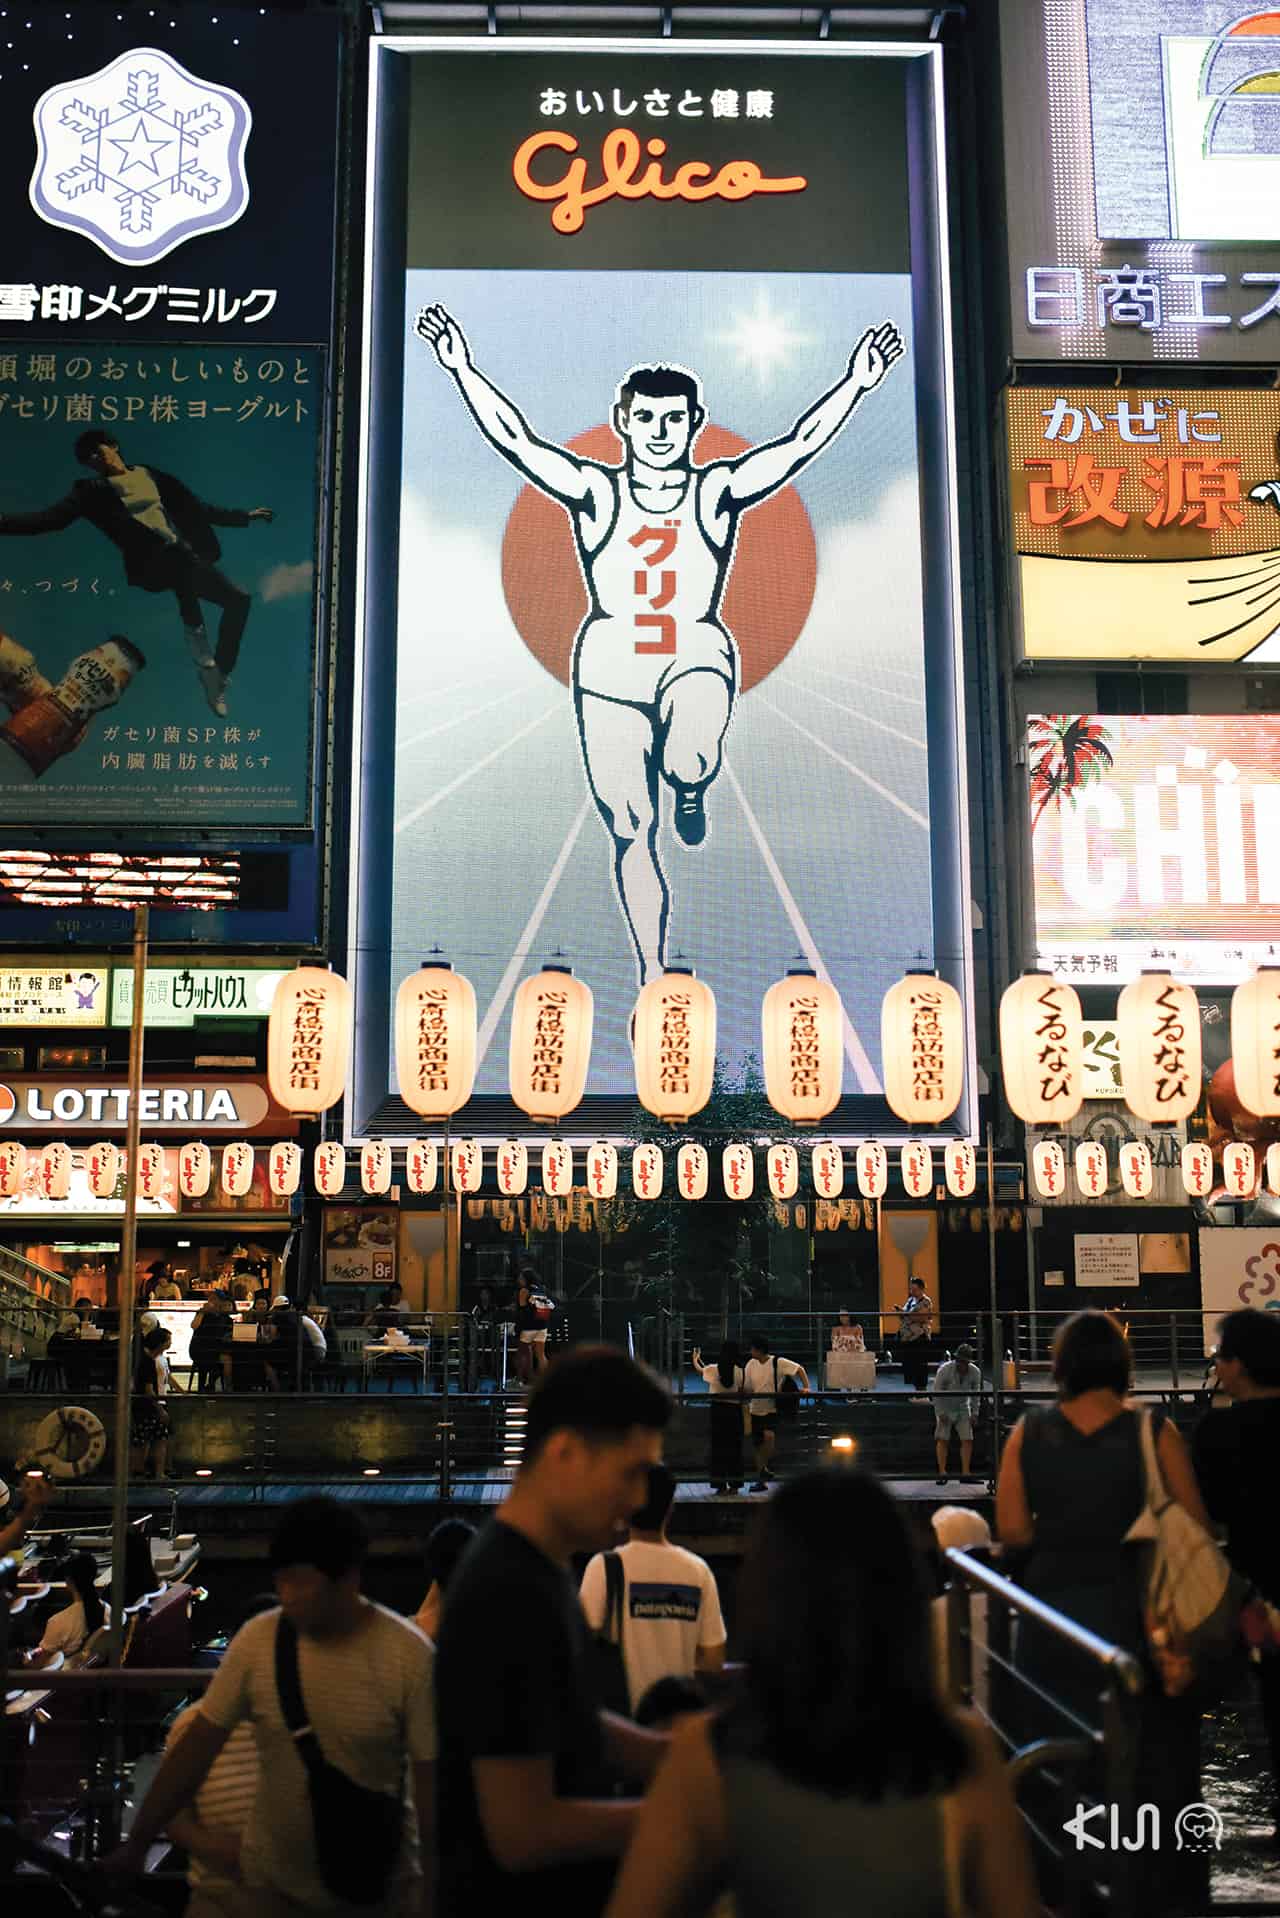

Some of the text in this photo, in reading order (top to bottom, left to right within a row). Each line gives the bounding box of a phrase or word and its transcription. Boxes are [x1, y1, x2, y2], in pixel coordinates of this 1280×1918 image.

[538, 87, 776, 119] おいしさと健康
[512, 127, 808, 233] Glico
[0, 283, 278, 323] 雪印メグミルク
[1041, 397, 1223, 443] かぜに
[1024, 454, 1247, 529] 改源
[628, 519, 681, 655] グリコ
[102, 725, 263, 746] ガセリ菌SP株が
[101, 751, 272, 771] 内臓脂肪を減らす
[1052, 954, 1119, 974] 天気予報
[0, 976, 63, 990] 情報館
[27, 1088, 239, 1121] LOTTERIA
